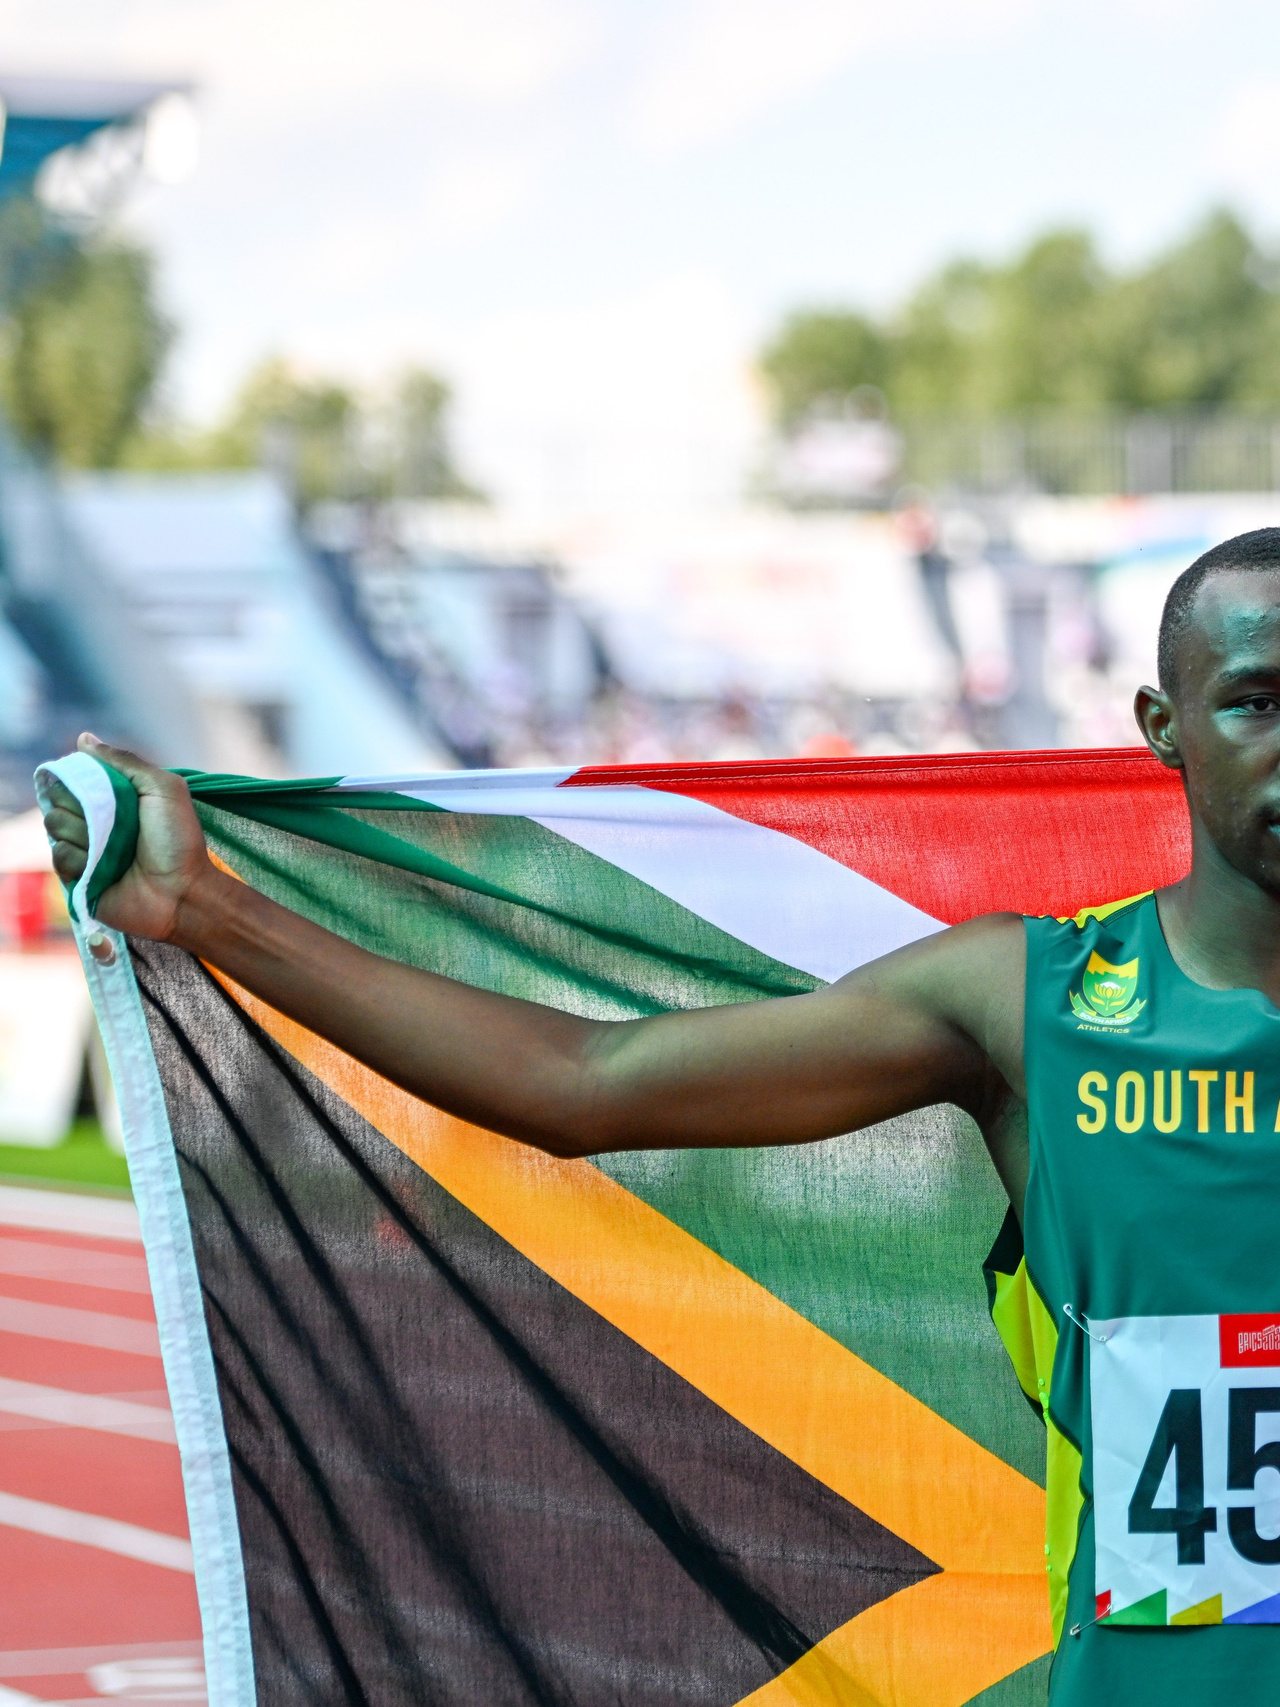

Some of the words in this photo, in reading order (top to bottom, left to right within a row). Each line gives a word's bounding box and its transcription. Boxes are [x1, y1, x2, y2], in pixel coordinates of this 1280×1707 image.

[1079, 1012, 1104, 1024] SOUTH
[1104, 1016, 1132, 1025] AFRICA
[1077, 1024, 1130, 1033] ATHLETICS
[1076, 1070, 1254, 1134] SOUTH
[1238, 1332, 1262, 1354] BRICS
